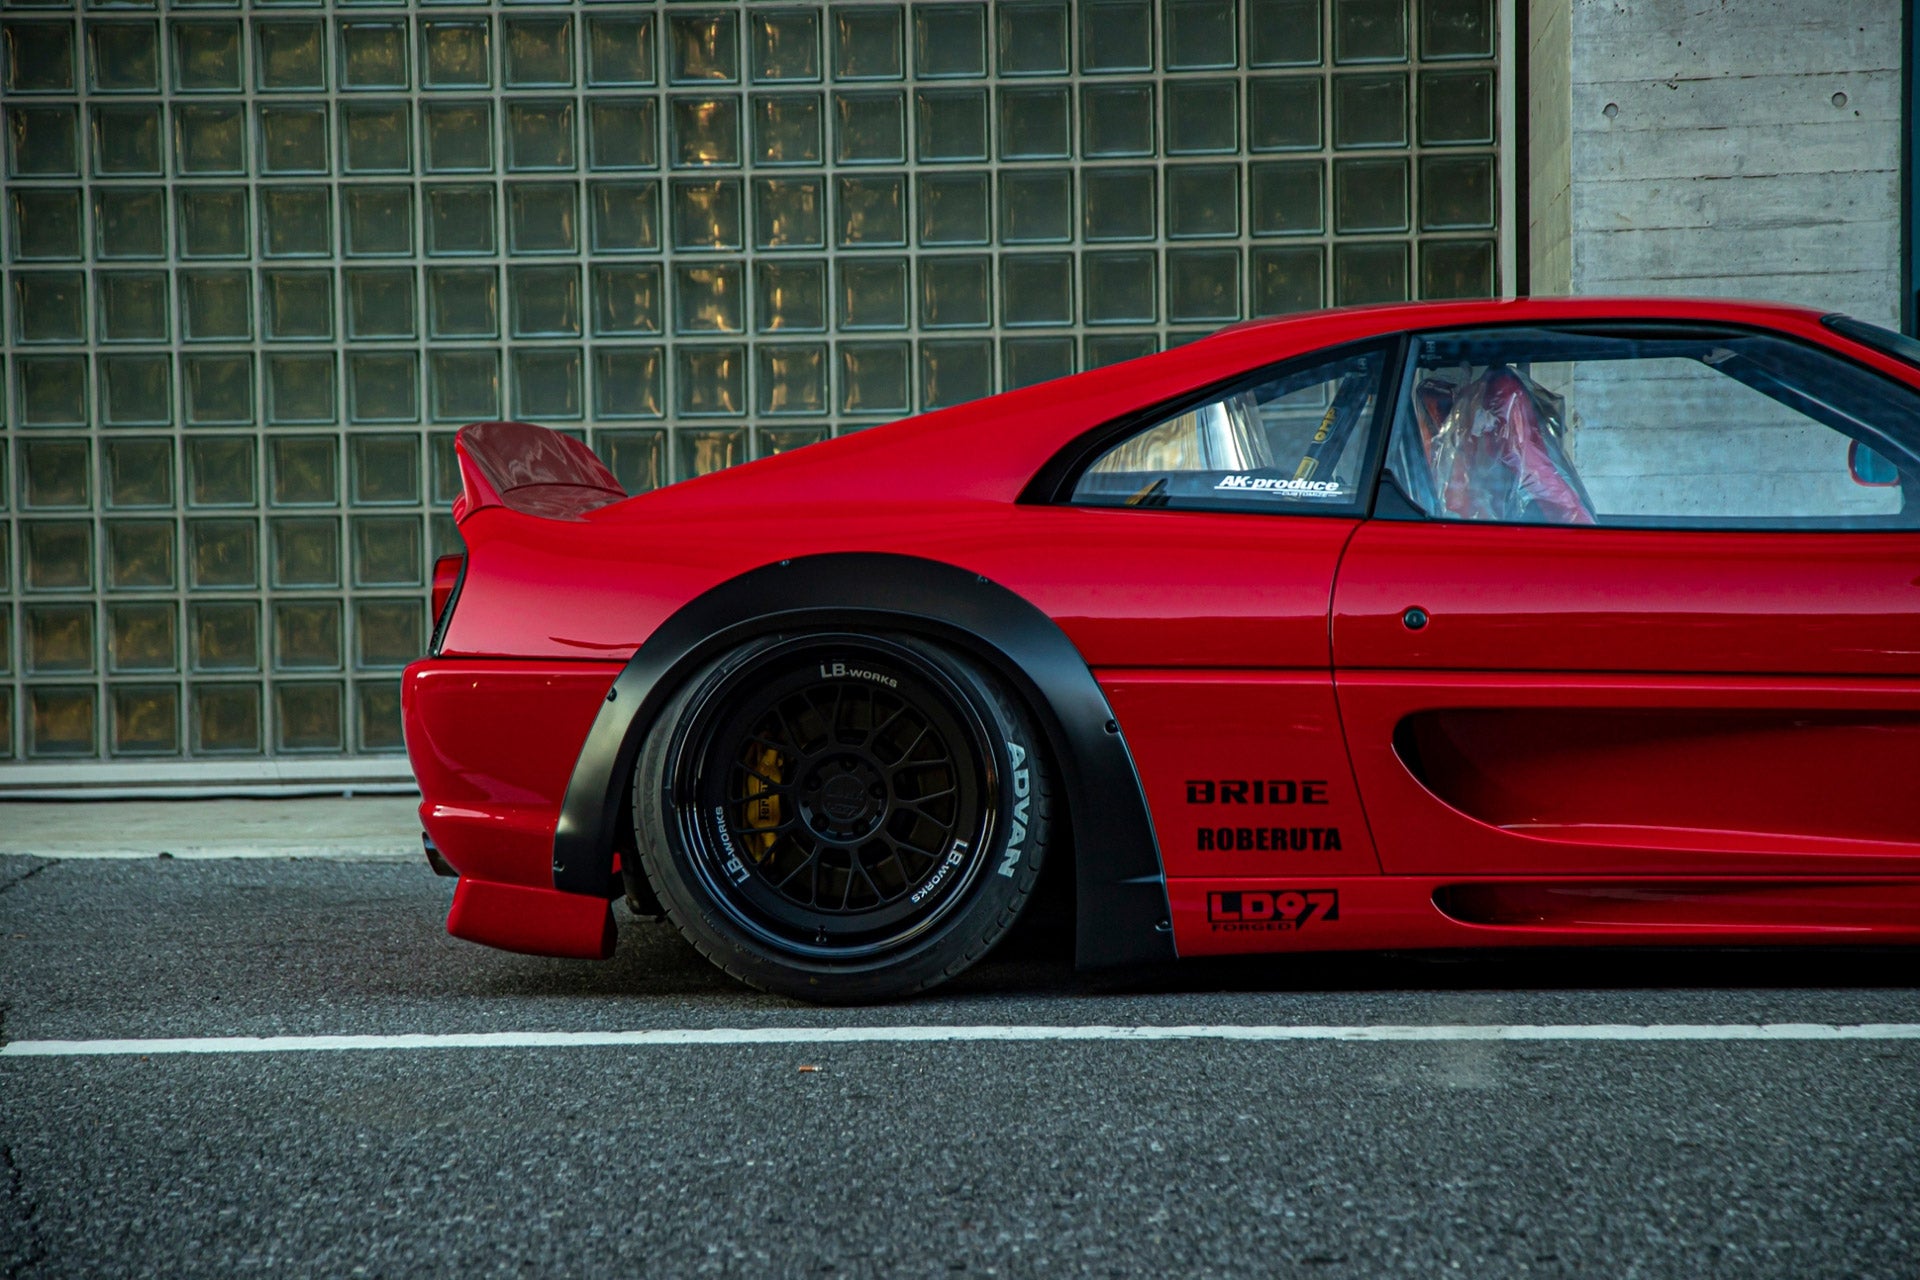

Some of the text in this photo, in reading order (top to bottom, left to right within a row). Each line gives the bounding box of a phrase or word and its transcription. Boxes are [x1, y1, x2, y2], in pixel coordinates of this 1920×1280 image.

[1219, 475, 1340, 492] AK-produce
[1186, 780, 1329, 804] BRIDE
[997, 741, 1031, 878] ADVAN
[1197, 827, 1342, 851] ROBERUTA
[1211, 922, 1291, 931] FORGED
